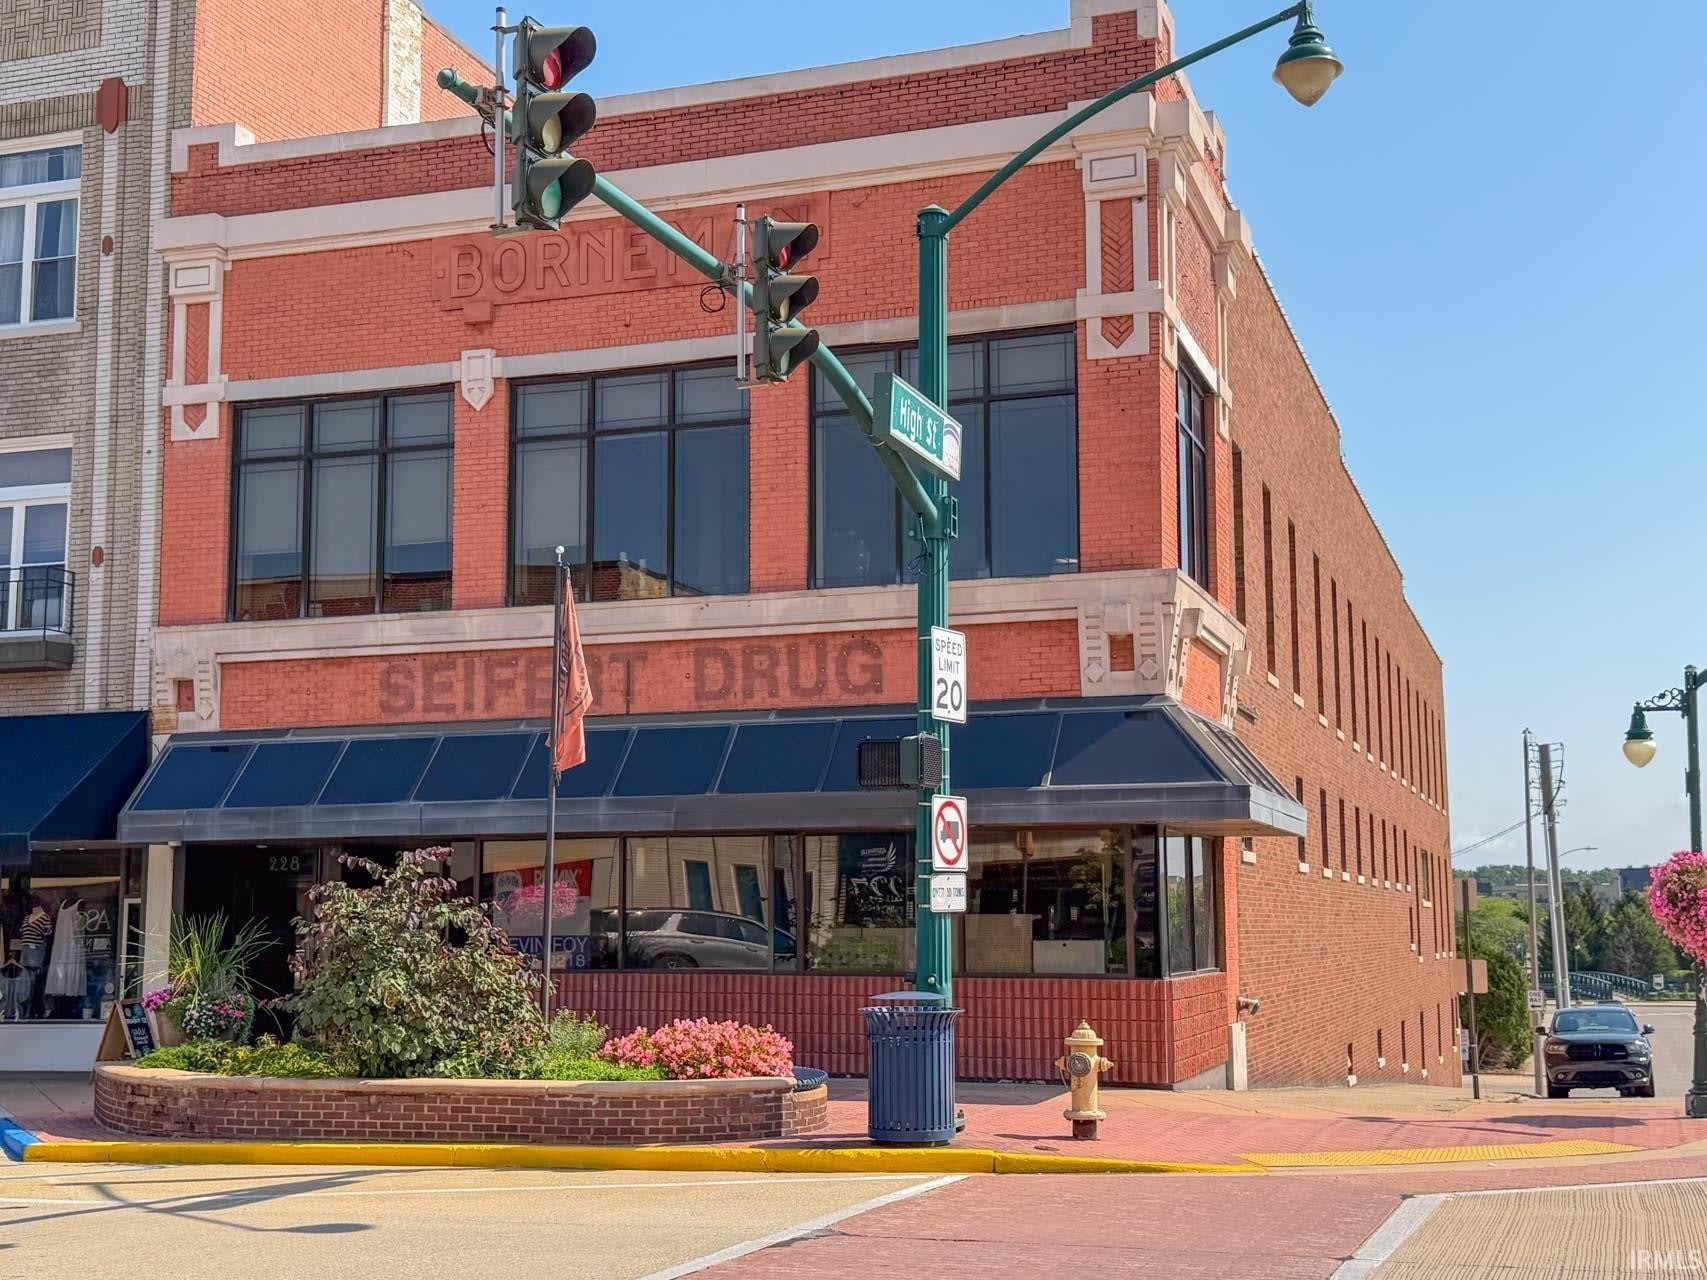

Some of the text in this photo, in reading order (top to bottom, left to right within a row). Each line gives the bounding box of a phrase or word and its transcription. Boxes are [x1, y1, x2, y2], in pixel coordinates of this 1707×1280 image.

[900, 397, 939, 449] High St
[935, 638, 963, 656] SPEED
[694, 638, 884, 697] DRUG
[938, 657, 960, 674] LIMIT
[936, 677, 963, 712] 20
[270, 855, 300, 871] 228
[552, 936, 588, 953] FOY
